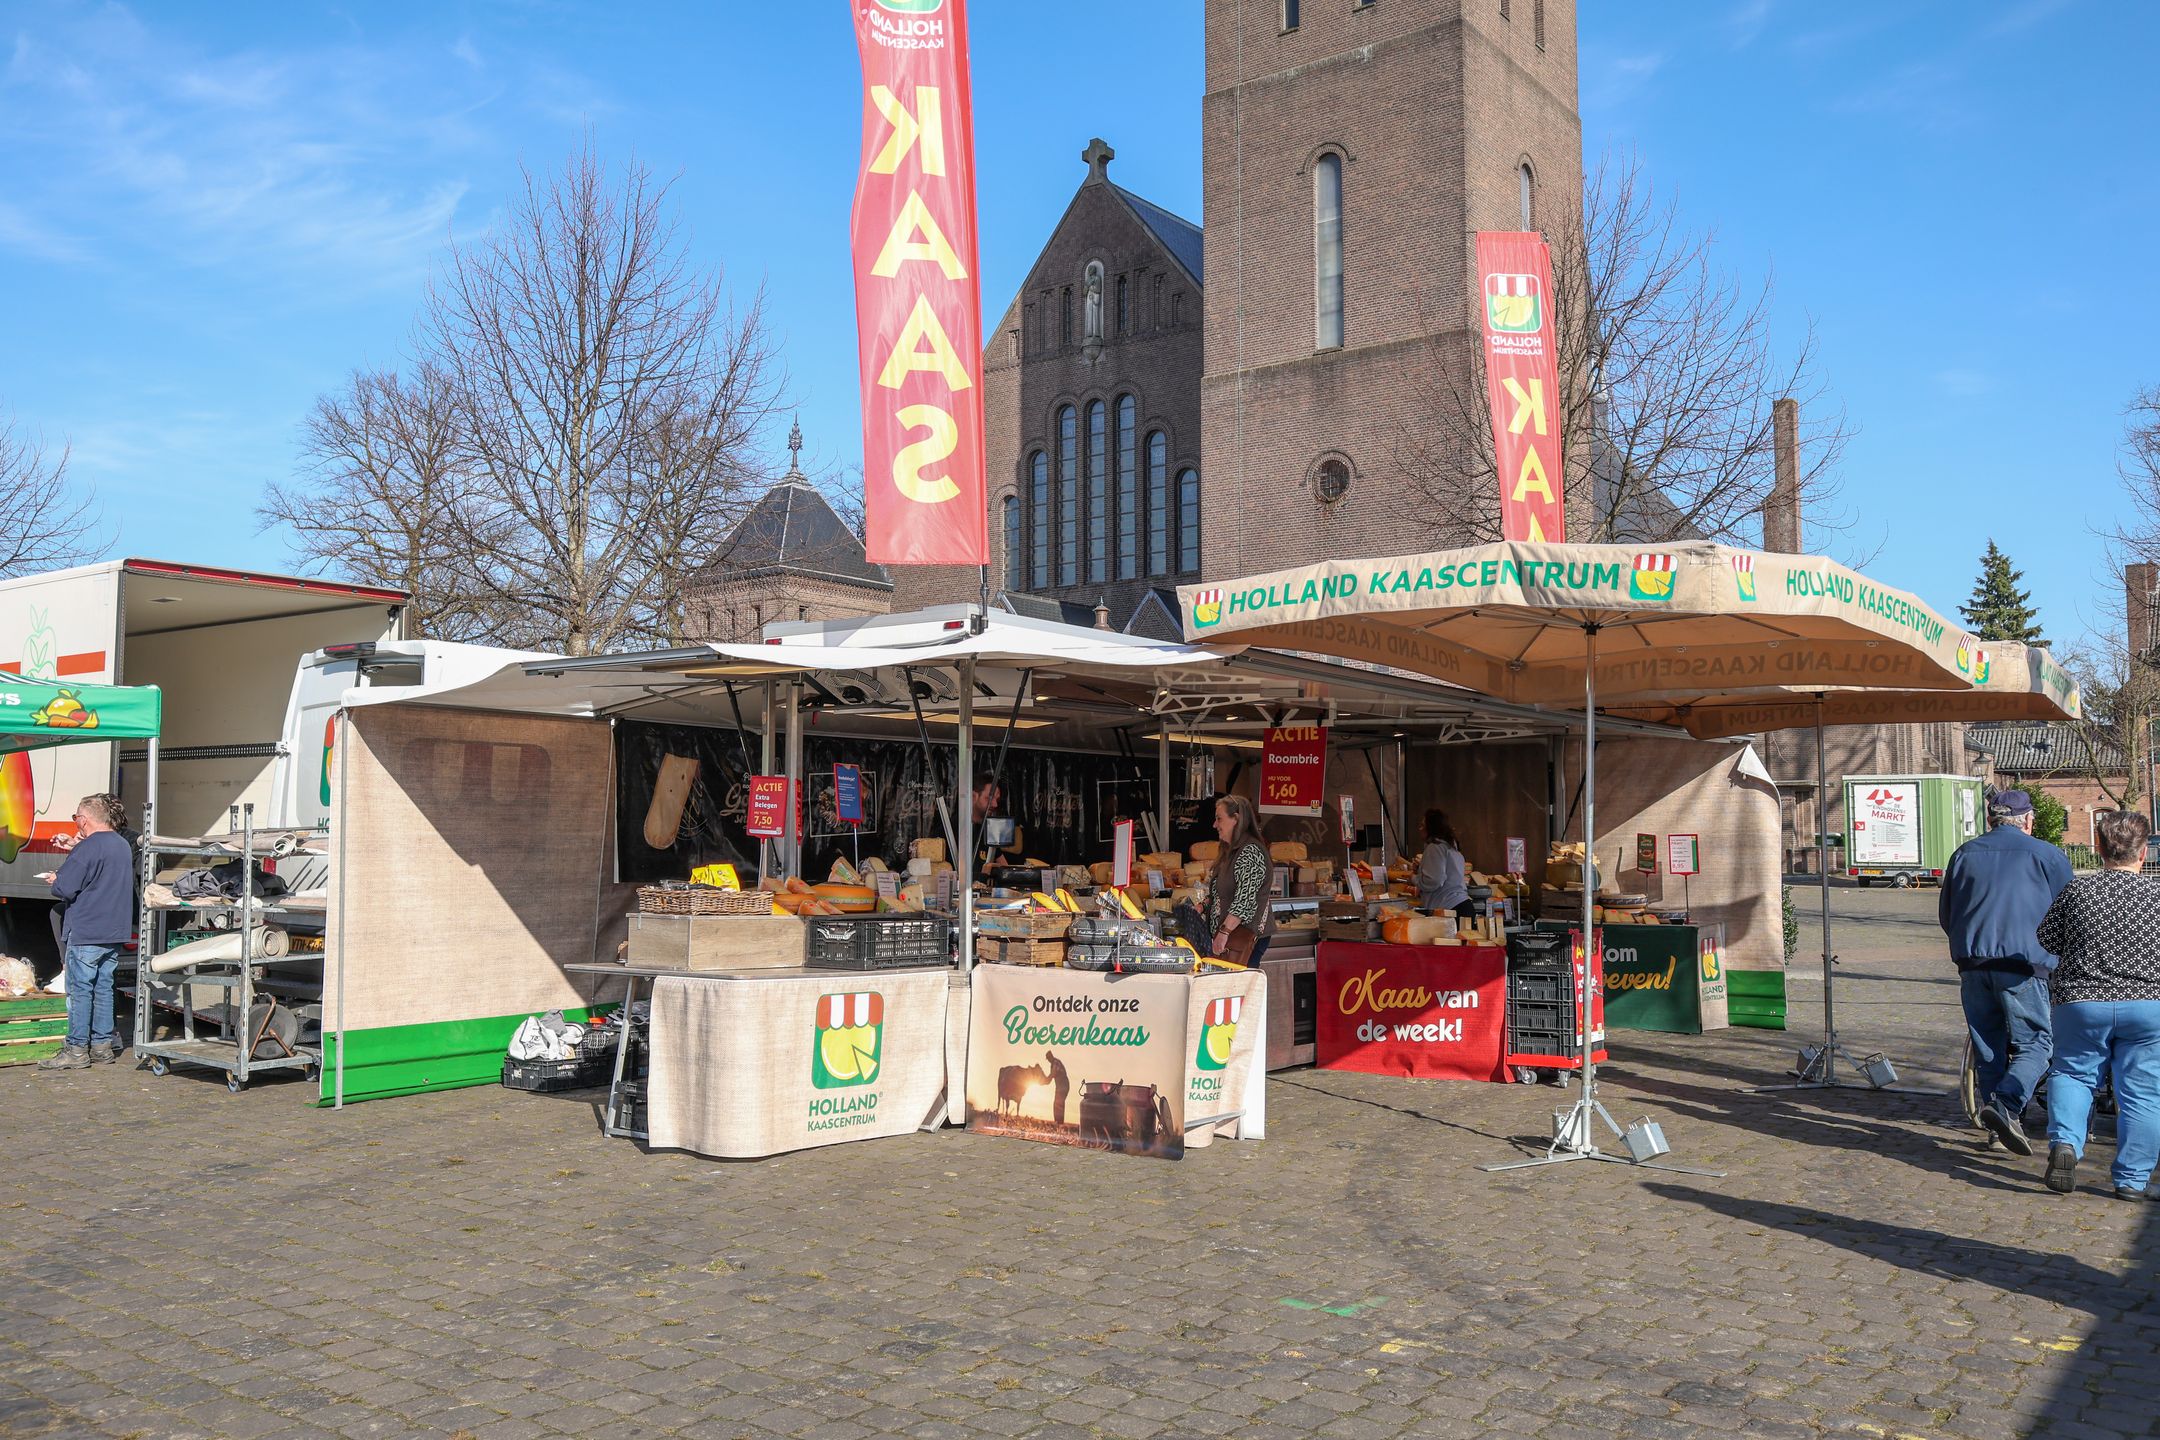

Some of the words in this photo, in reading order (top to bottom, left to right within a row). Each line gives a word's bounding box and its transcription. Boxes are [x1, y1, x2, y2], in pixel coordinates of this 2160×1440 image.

[1228, 573, 1358, 614] HOLLAND
[1369, 560, 1621, 594] KAASCENTRUM
[1786, 568, 1854, 604] HOLLAND
[1858, 583, 1945, 648] KAASCENTRUM
[1271, 727, 1320, 742] ACTIE
[1268, 753, 1320, 764] Roombrie
[756, 783, 783, 792] ACTIE
[1268, 784, 1297, 799] 1,60
[754, 802, 778, 810] Belegen
[754, 816, 772, 826] 7,50
[1871, 810, 1906, 822] MARKT
[1338, 968, 1432, 1015] Kaas
[1435, 989, 1479, 1008] van
[1032, 995, 1094, 1012] Ontdek
[1097, 998, 1140, 1013] onze
[1002, 1004, 1150, 1047] Boerenkaas
[1356, 1018, 1387, 1042] de
[1392, 1018, 1463, 1042] week!
[808, 1093, 878, 1117] HOLLAND
[807, 1113, 876, 1132] KAASCENTRUM
